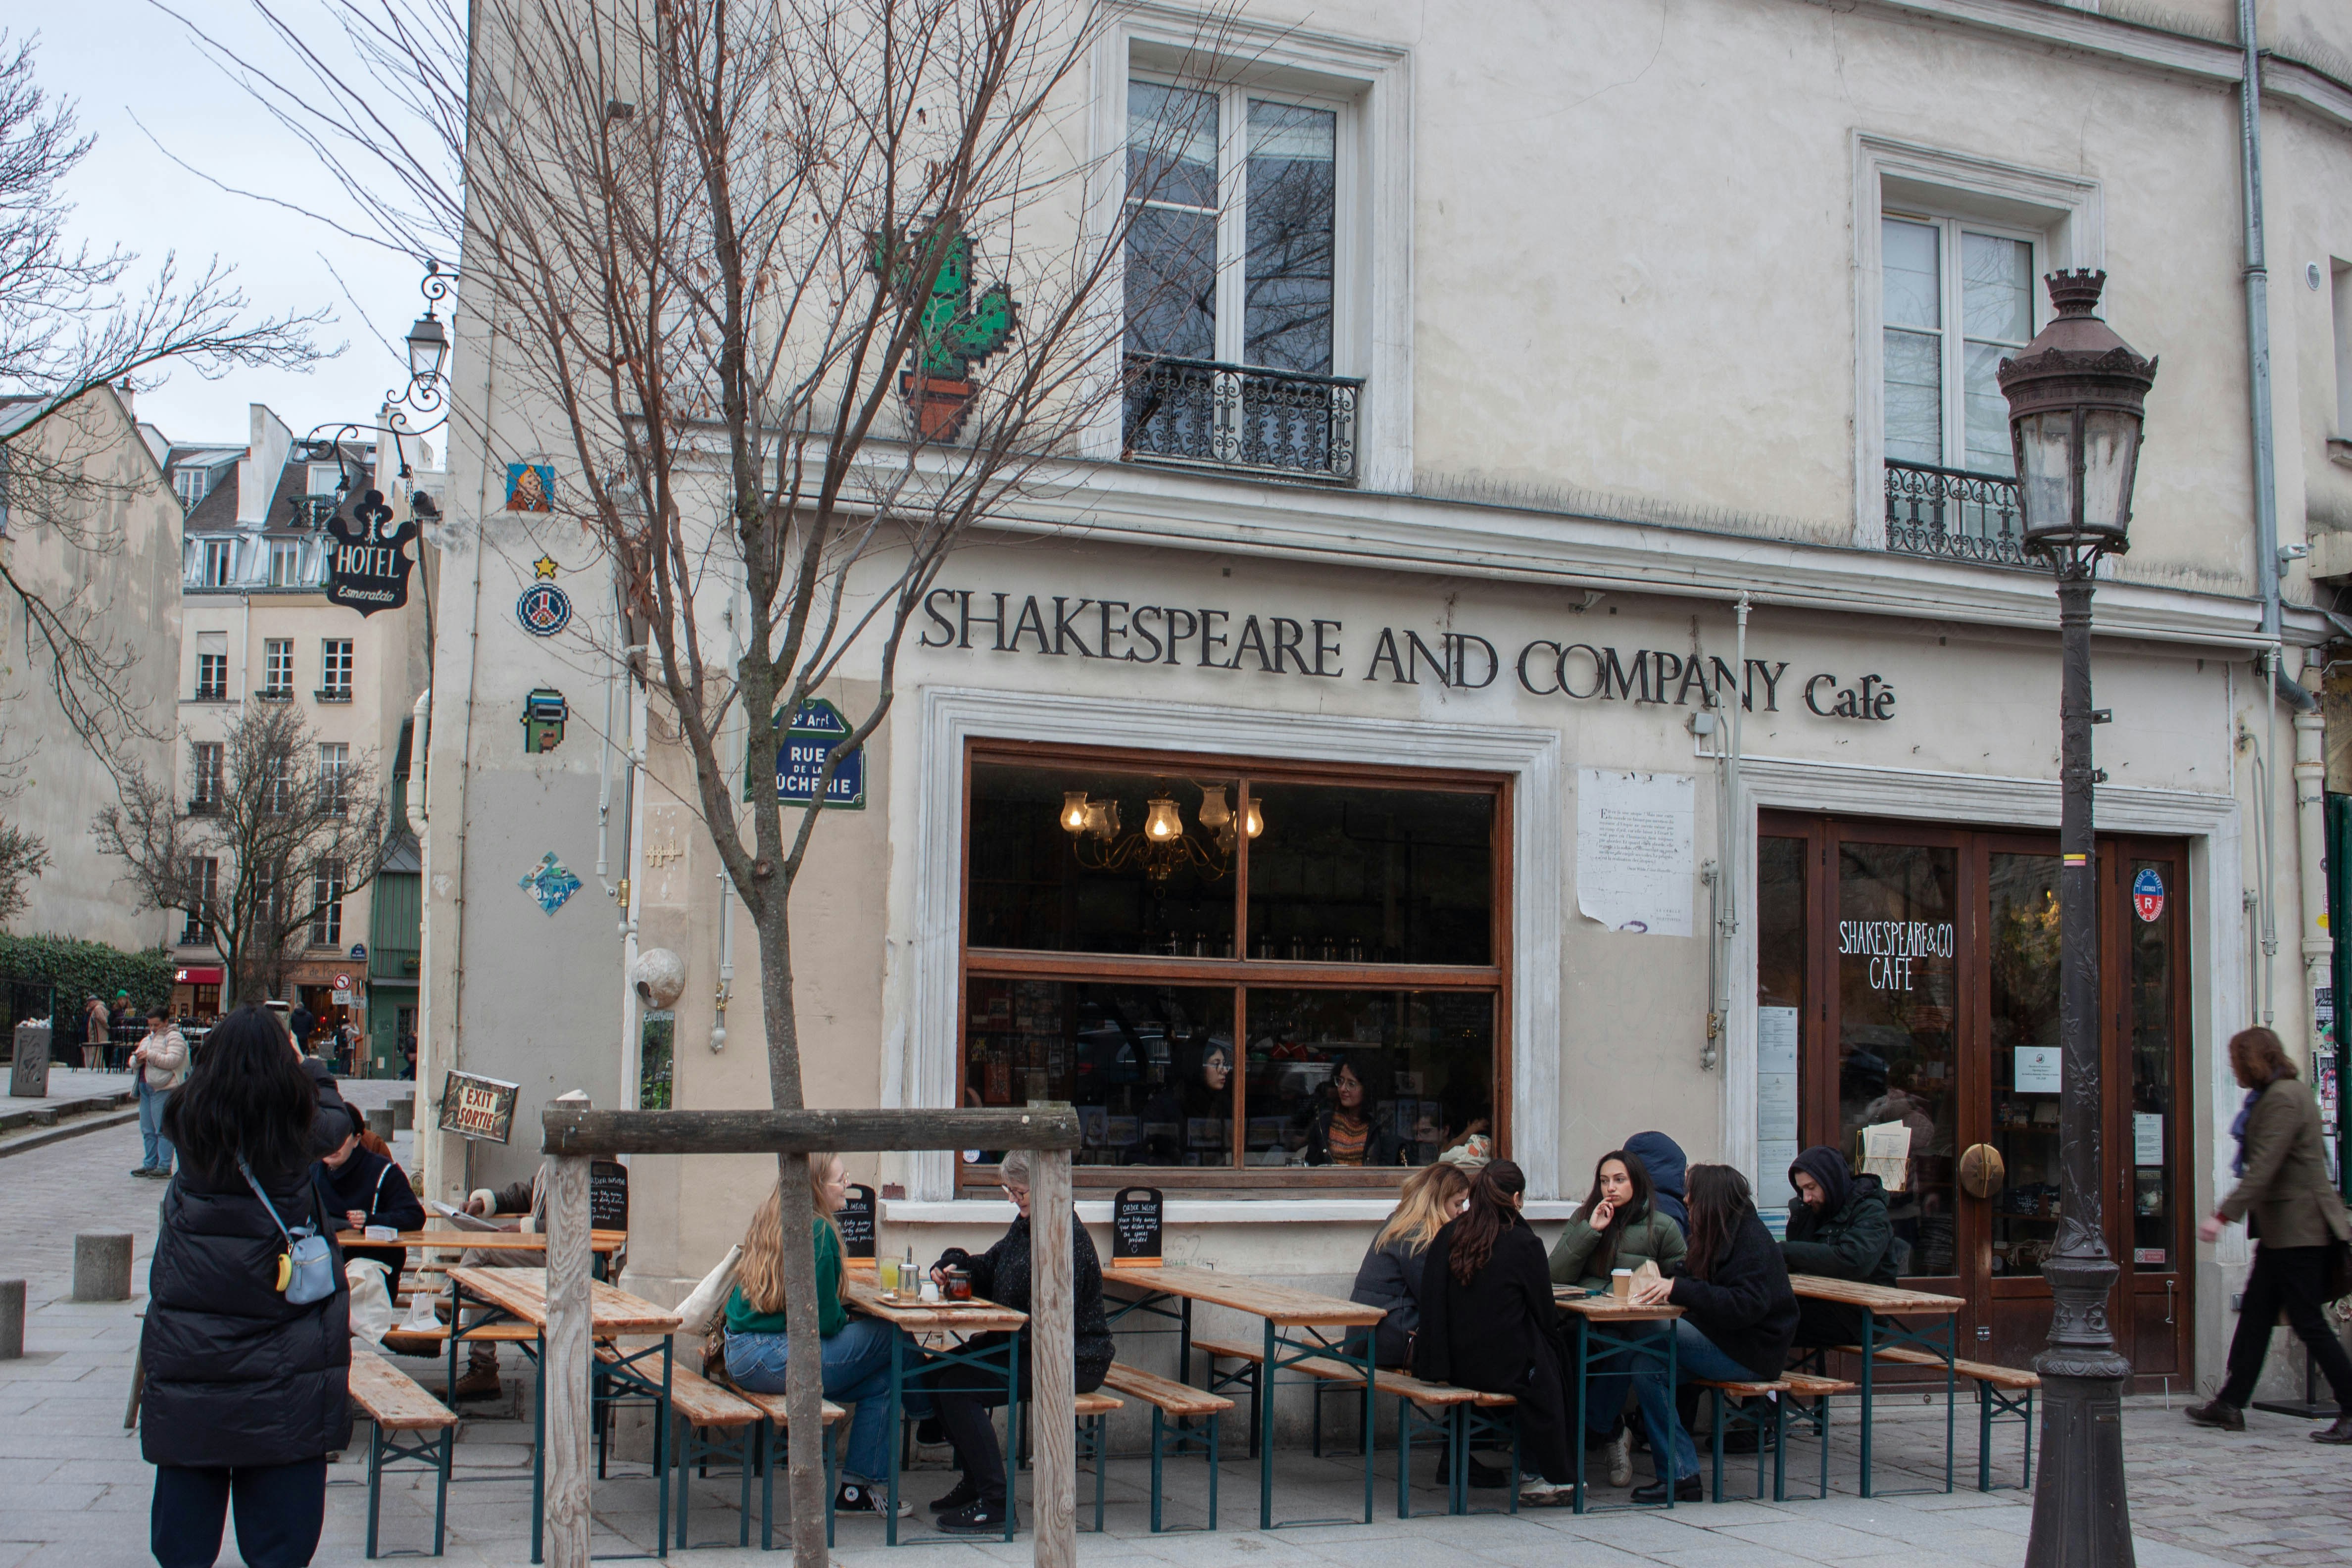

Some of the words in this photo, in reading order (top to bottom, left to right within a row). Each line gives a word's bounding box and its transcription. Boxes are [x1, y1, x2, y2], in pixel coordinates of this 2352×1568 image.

[337, 544, 400, 578] HOTEL
[920, 588, 1343, 678] SHAKESPEARE
[1363, 627, 1499, 689] AND
[1517, 640, 1790, 713] COMPANY
[1804, 674, 1896, 721] Café
[791, 746, 826, 763] RUE
[794, 765, 806, 774] DE
[812, 766, 823, 775] LA
[2144, 897, 2153, 910] R
[1869, 957, 1913, 990] CAFE
[466, 1088, 494, 1109] EXIT
[458, 1107, 494, 1129] SORTIE
[844, 1219, 855, 1228] tidy
[1118, 1217, 1130, 1226] please
[1128, 1237, 1148, 1246] provided
